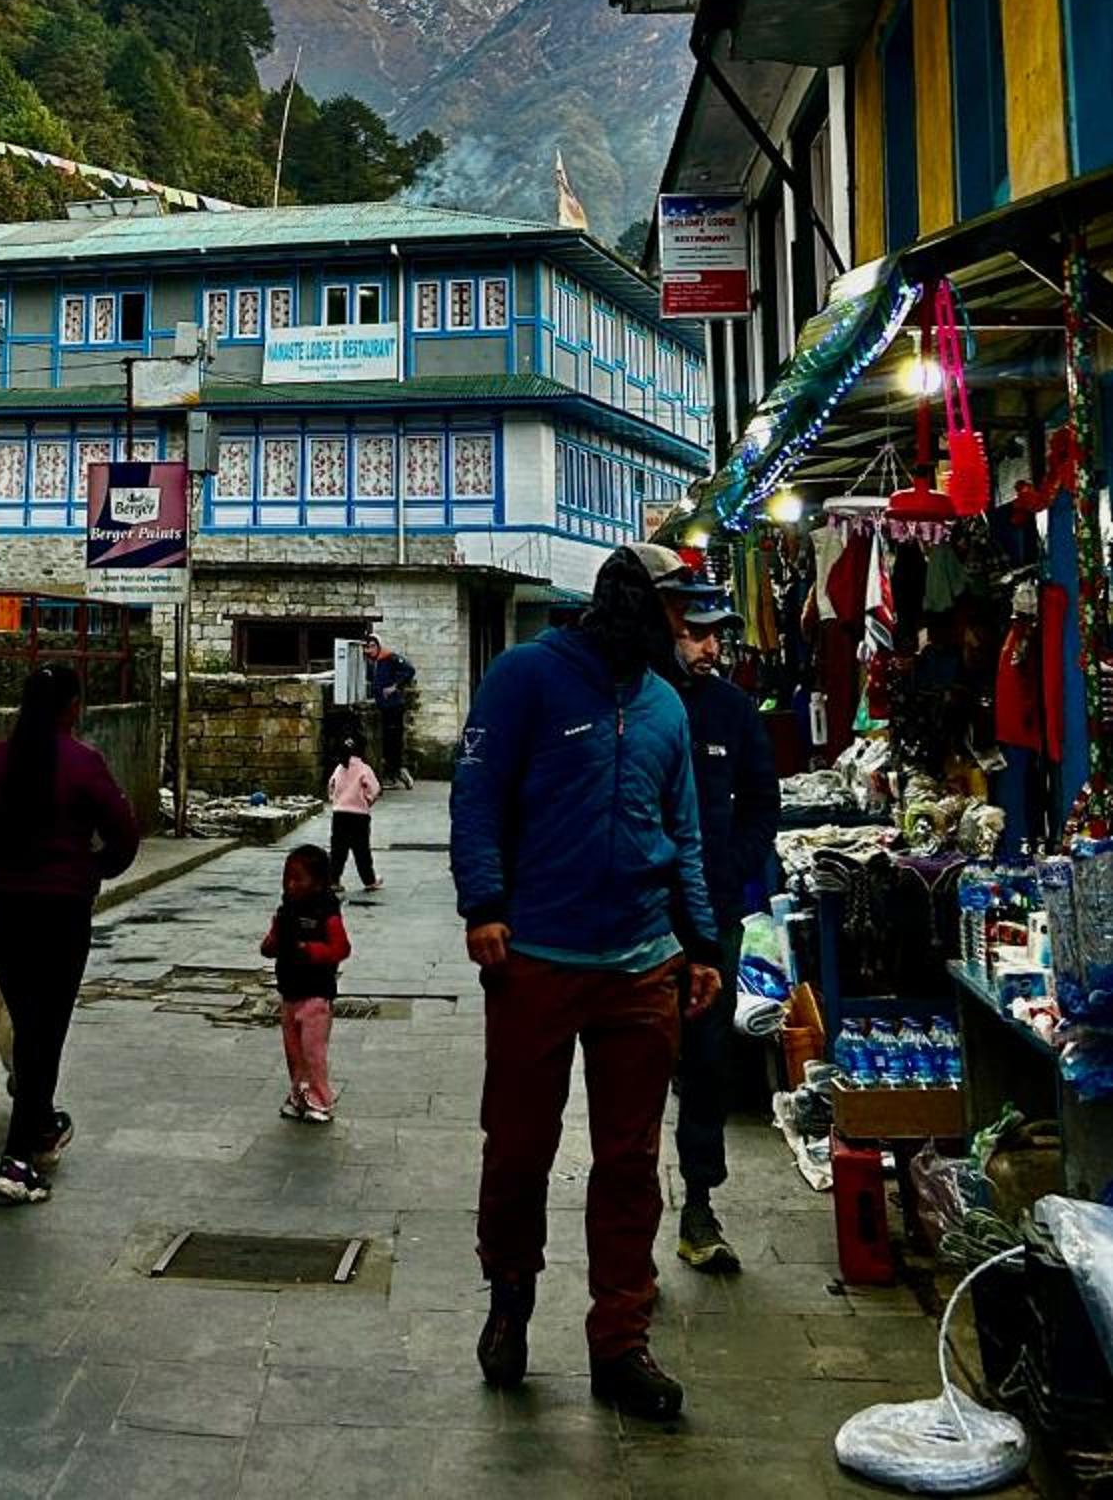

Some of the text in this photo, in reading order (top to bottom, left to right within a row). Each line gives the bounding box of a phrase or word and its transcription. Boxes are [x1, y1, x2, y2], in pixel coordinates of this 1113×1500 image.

[114, 501, 156, 519] Berger
[90, 526, 183, 543] Berger Paints
